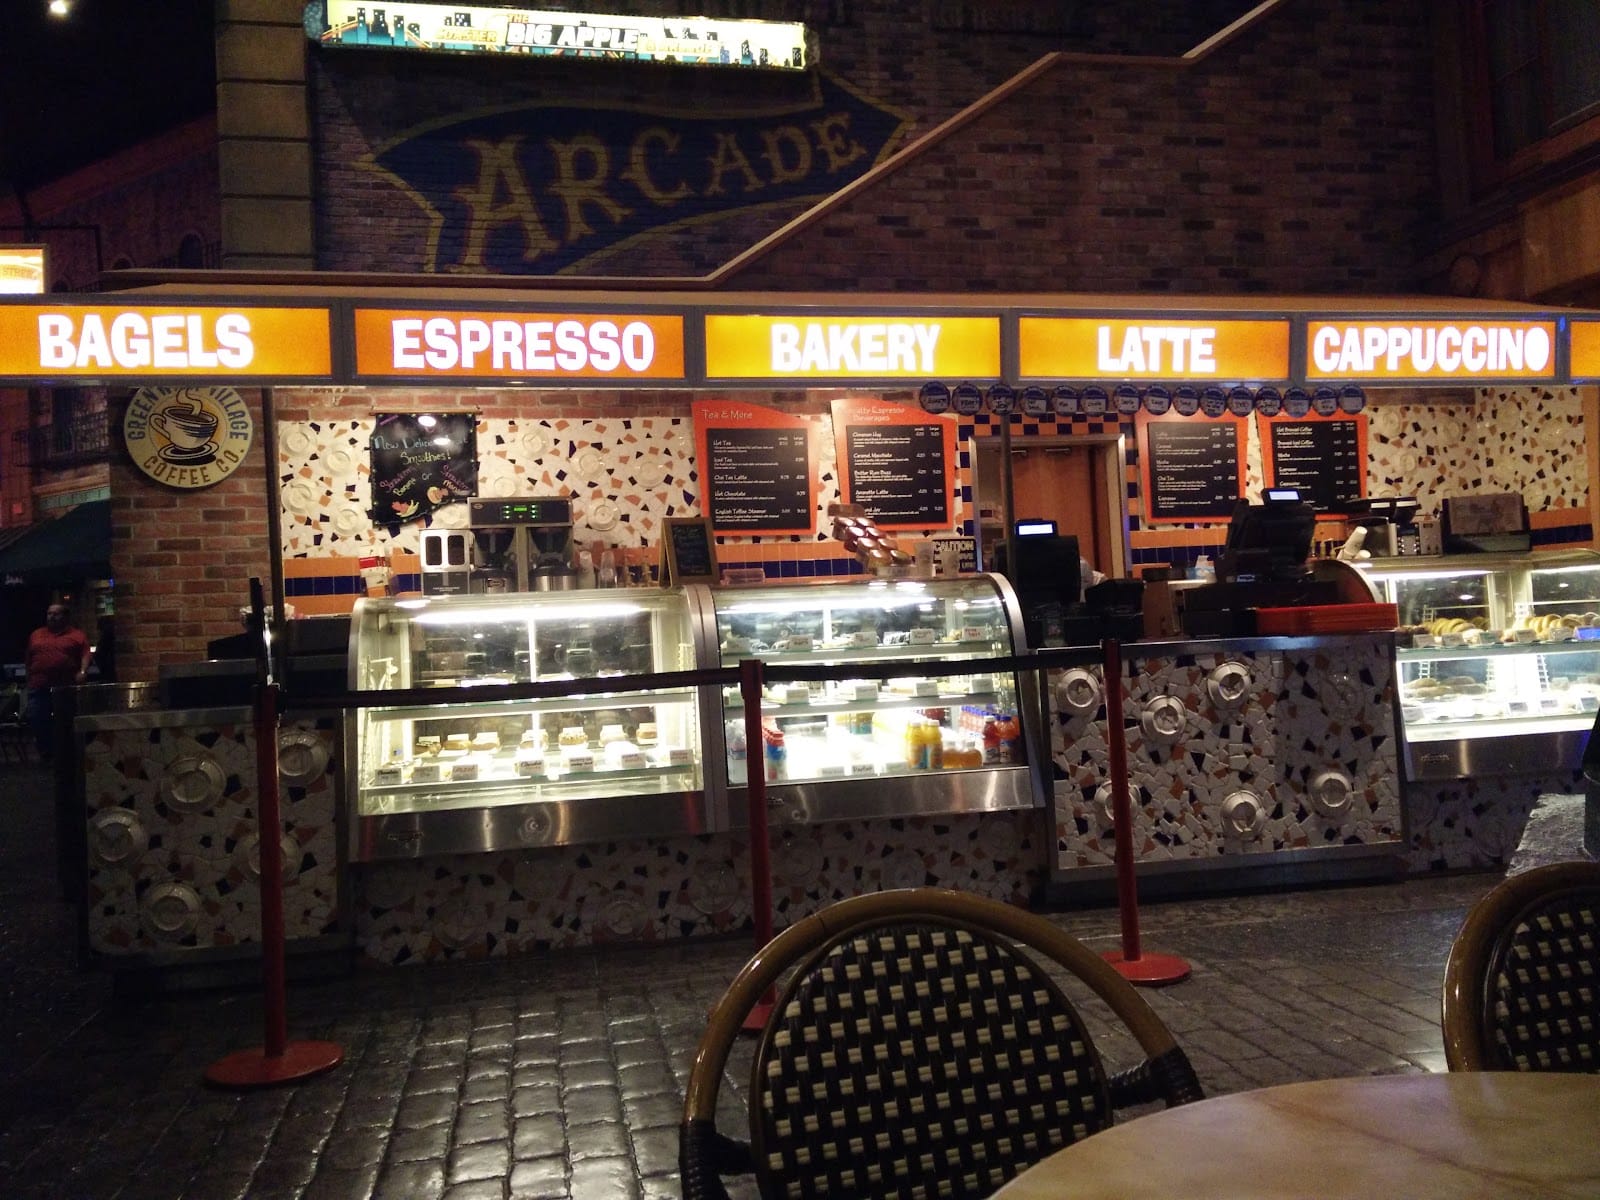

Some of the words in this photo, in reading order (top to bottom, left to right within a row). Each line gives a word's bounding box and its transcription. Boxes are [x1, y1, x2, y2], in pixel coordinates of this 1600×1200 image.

[507, 14, 530, 24] THE
[507, 22, 553, 46] BIG
[556, 25, 639, 51] APPLE
[445, 112, 867, 273] ARCADE
[38, 312, 254, 369] BAGELS
[391, 317, 655, 372] ESPRESSO
[771, 323, 941, 373] BAKERY
[1097, 325, 1217, 373] LATTE
[1313, 326, 1550, 373] CAPPUCCINO
[702, 409, 718, 420] Tea
[730, 410, 753, 421] More
[374, 435, 399, 450] New
[400, 450, 452, 465] Smoothies!
[143, 455, 211, 485] COFFEE
[215, 449, 245, 473] CO.
[421, 472, 433, 480] or
[933, 539, 975, 552] CAUTION
